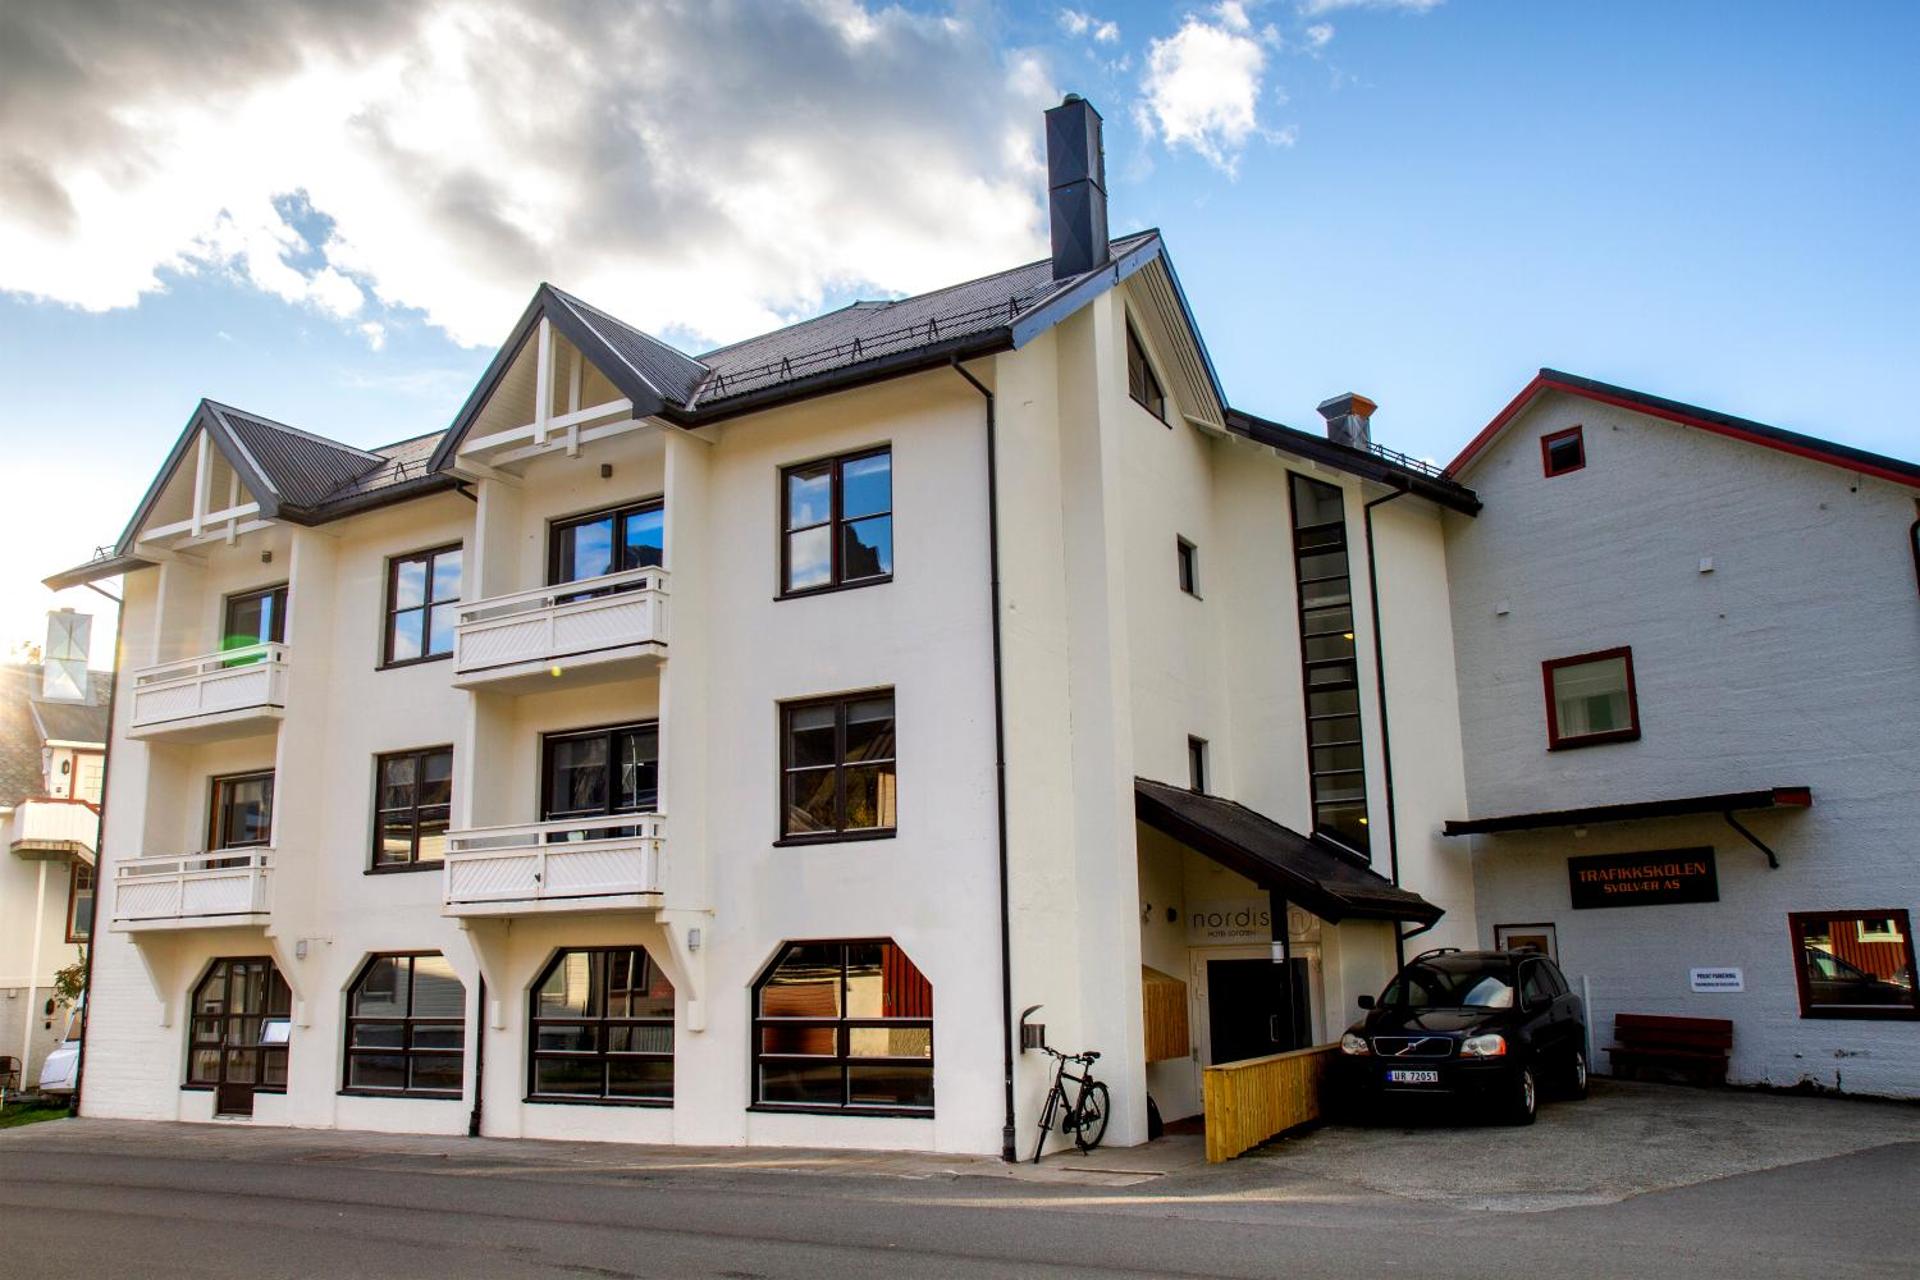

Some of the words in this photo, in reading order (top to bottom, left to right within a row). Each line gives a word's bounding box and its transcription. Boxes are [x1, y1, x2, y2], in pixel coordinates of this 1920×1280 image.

[1579, 861, 1706, 882] TRAFIKKSKOLEN
[1664, 879, 1680, 889] AS
[1193, 907, 1270, 928] nordis
[1394, 1071, 1407, 1080] UR
[1410, 1072, 1437, 1081] 72051
